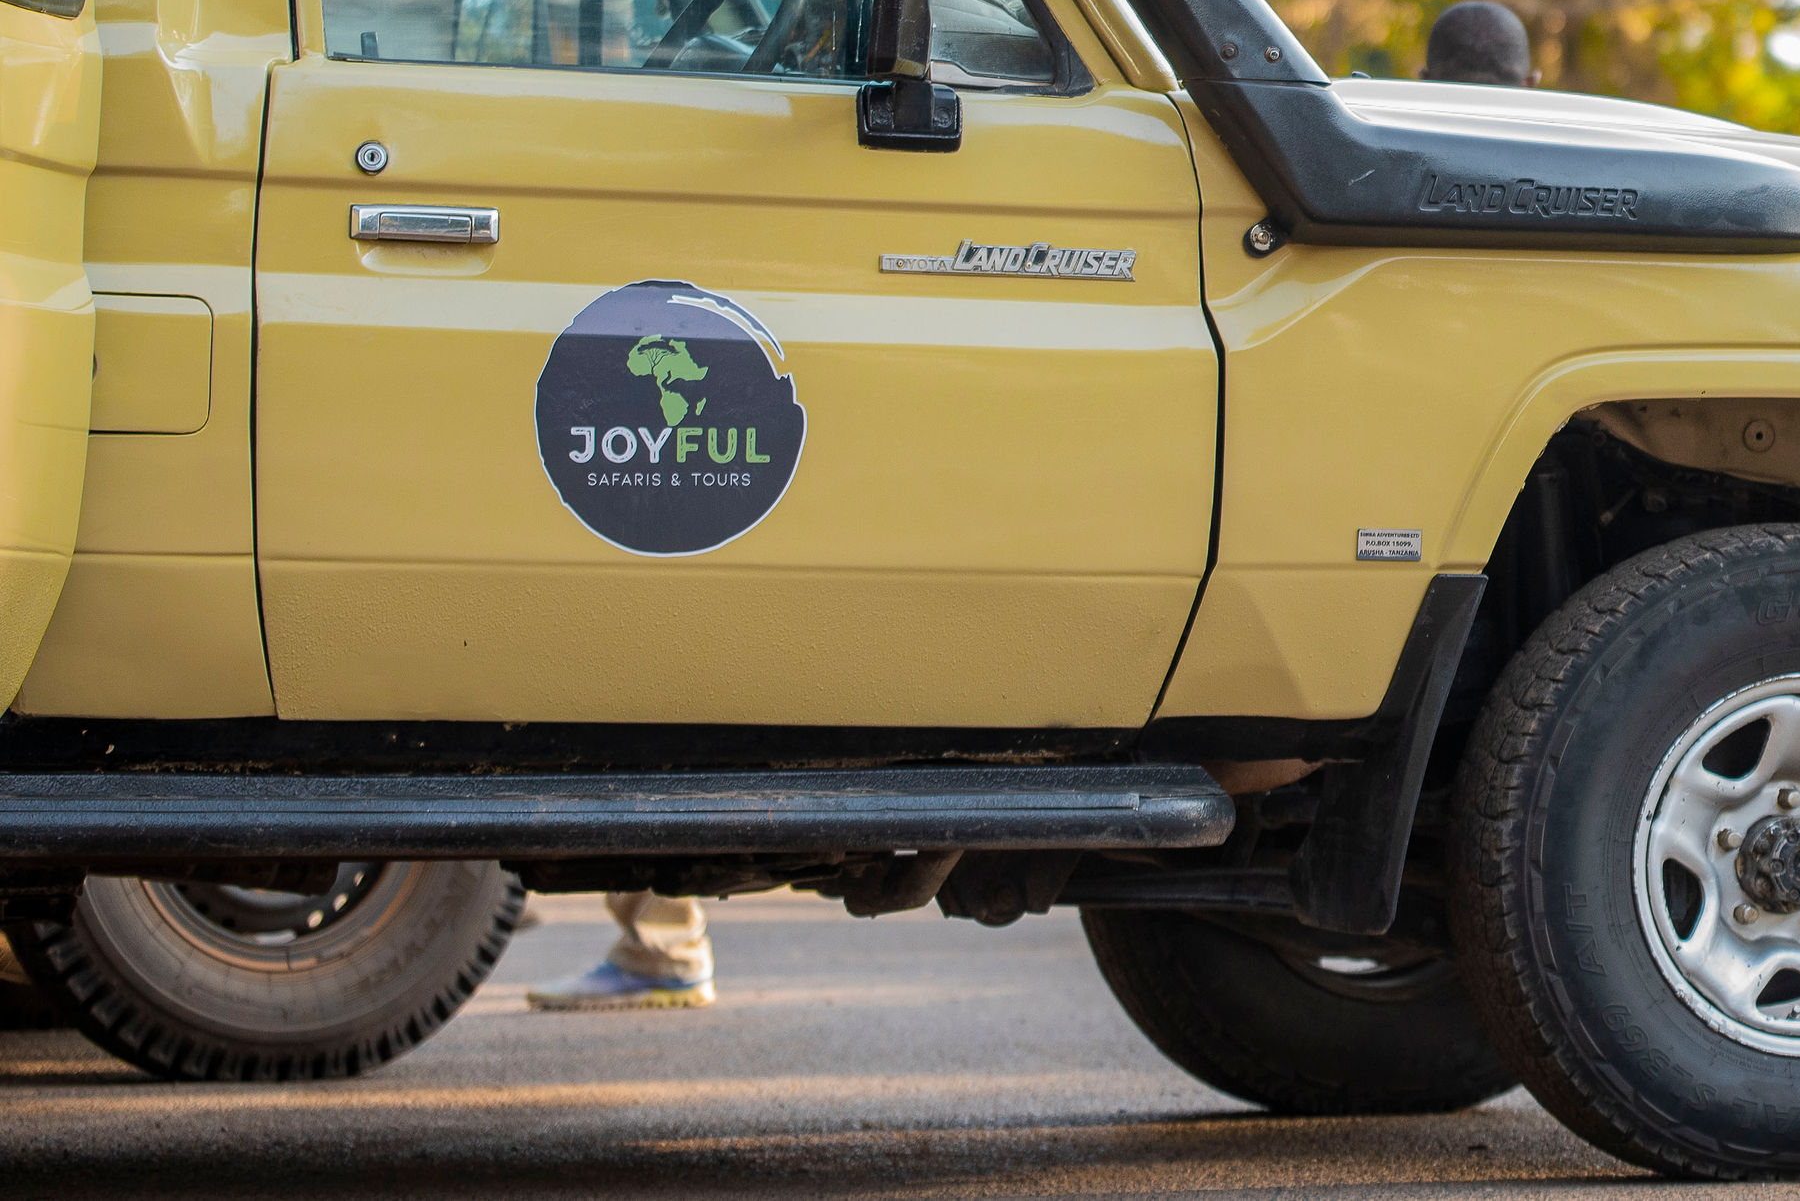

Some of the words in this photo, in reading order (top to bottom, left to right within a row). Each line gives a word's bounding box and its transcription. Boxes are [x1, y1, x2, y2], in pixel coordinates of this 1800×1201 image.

[1418, 174, 1507, 213] LAND
[1508, 177, 1639, 221] CRUISER
[885, 257, 949, 272] TOYOTA
[952, 239, 1027, 273] LAND
[1024, 241, 1137, 281] CRUISER
[568, 425, 772, 465] JOYFUL
[587, 472, 662, 488] SAFARIS
[670, 473, 682, 487] &
[691, 473, 752, 488] TOURS
[1388, 549, 1419, 557] TANZANIA
[1563, 881, 1609, 976] A/T
